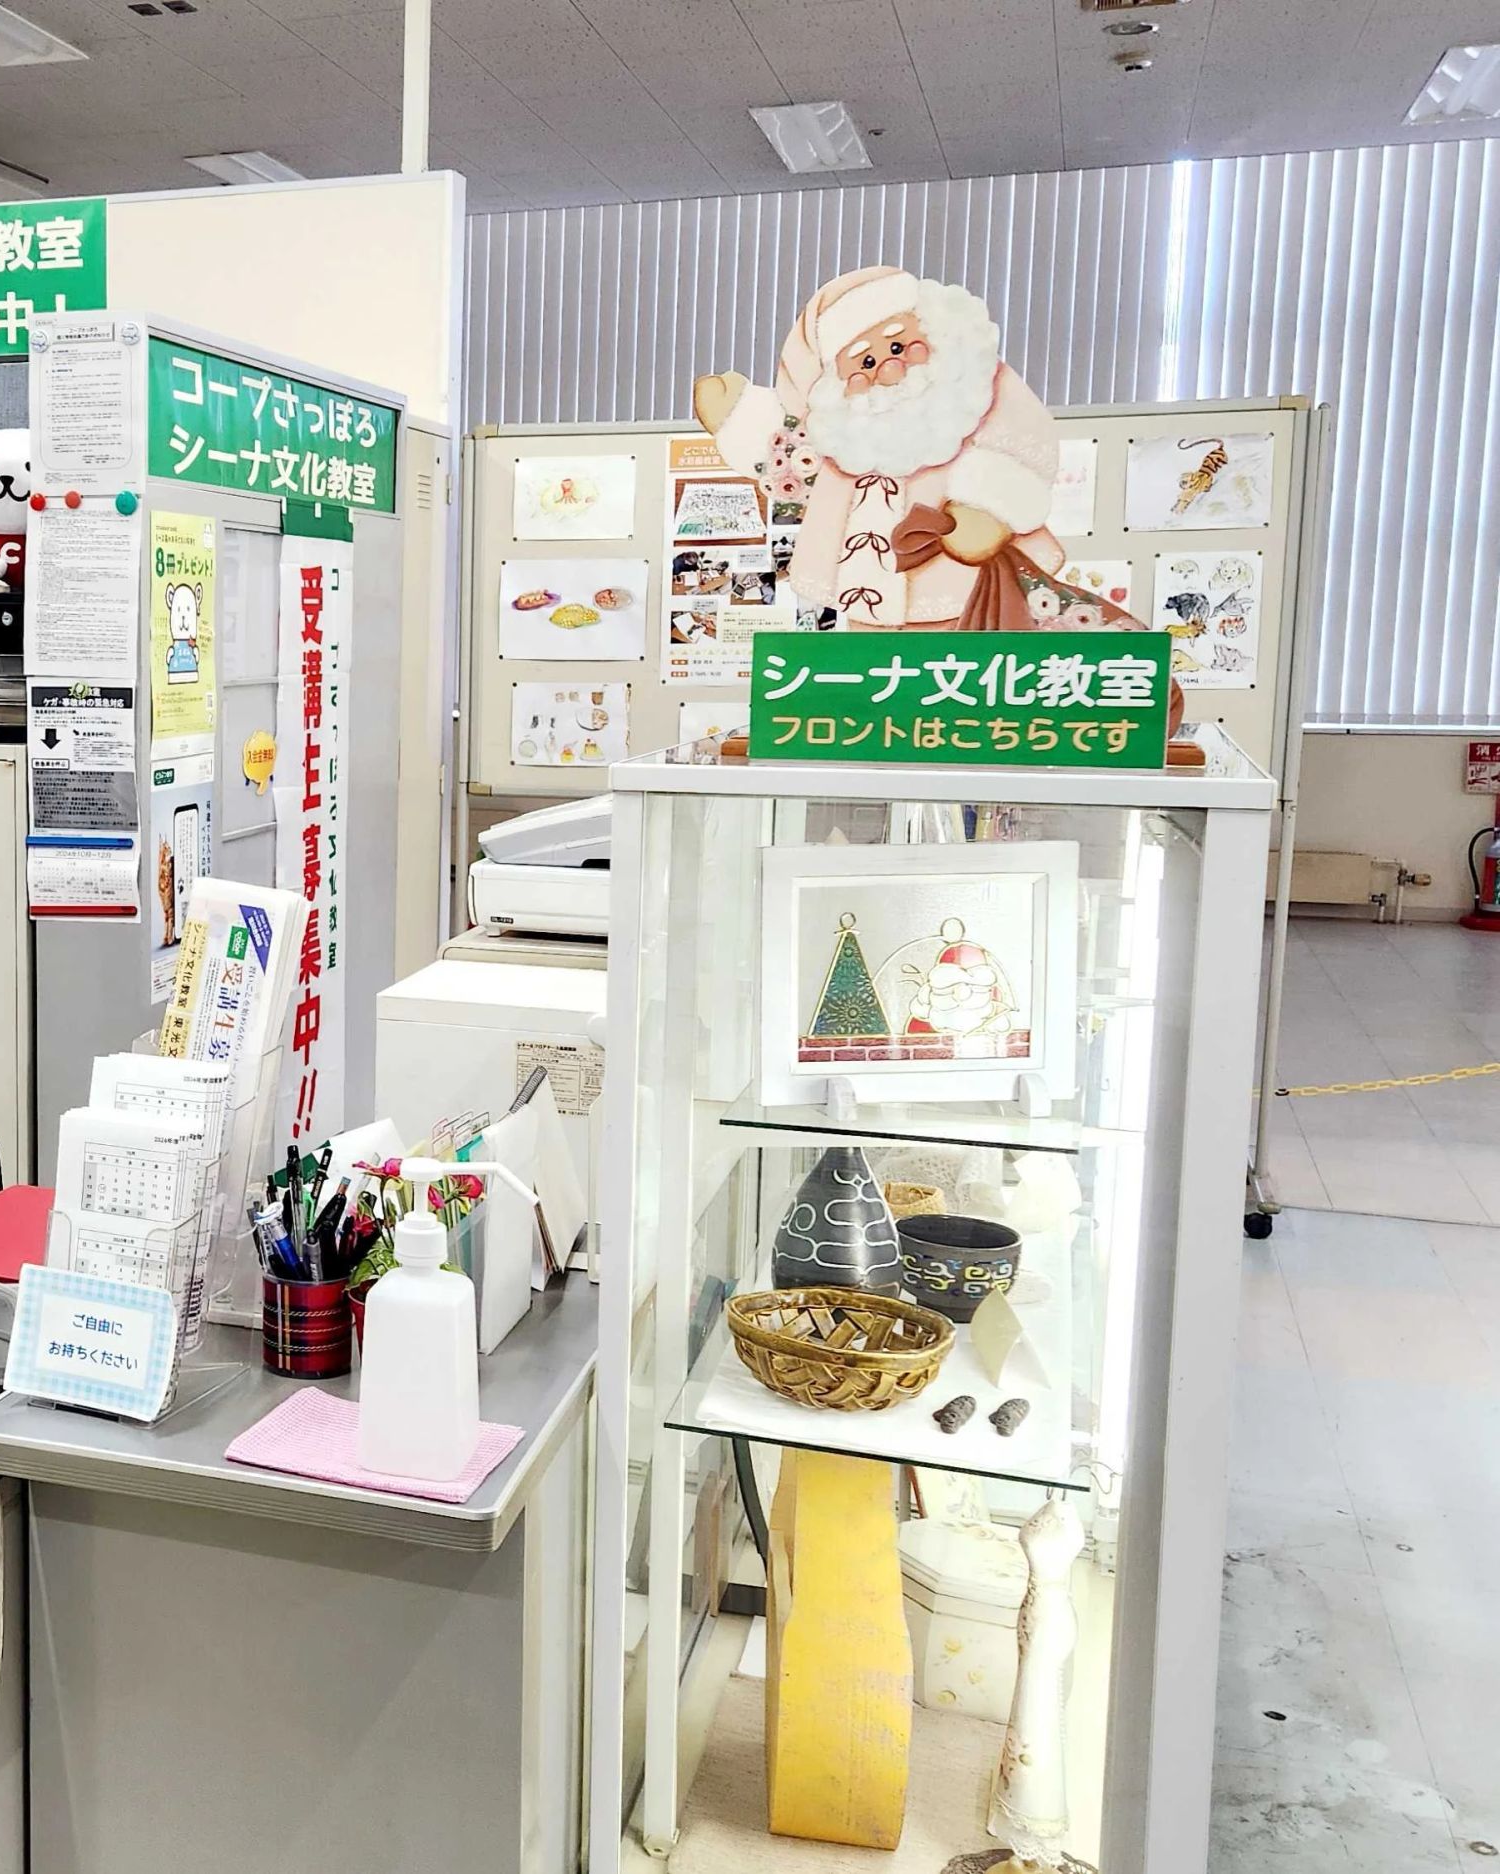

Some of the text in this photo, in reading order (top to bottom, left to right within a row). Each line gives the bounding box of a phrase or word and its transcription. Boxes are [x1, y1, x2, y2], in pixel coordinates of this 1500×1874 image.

[172, 357, 377, 448] コープさっぽろ
[169, 424, 377, 504] シーナ文化教室
[0, 542, 22, 565] C
[762, 653, 1157, 708] シーナ文化教室
[771, 715, 1141, 755] フロントはこちらです
[177, 923, 202, 1008] シーナ文化教室
[72, 1313, 123, 1336] ご自由に
[48, 1340, 138, 1371] お持ちください
